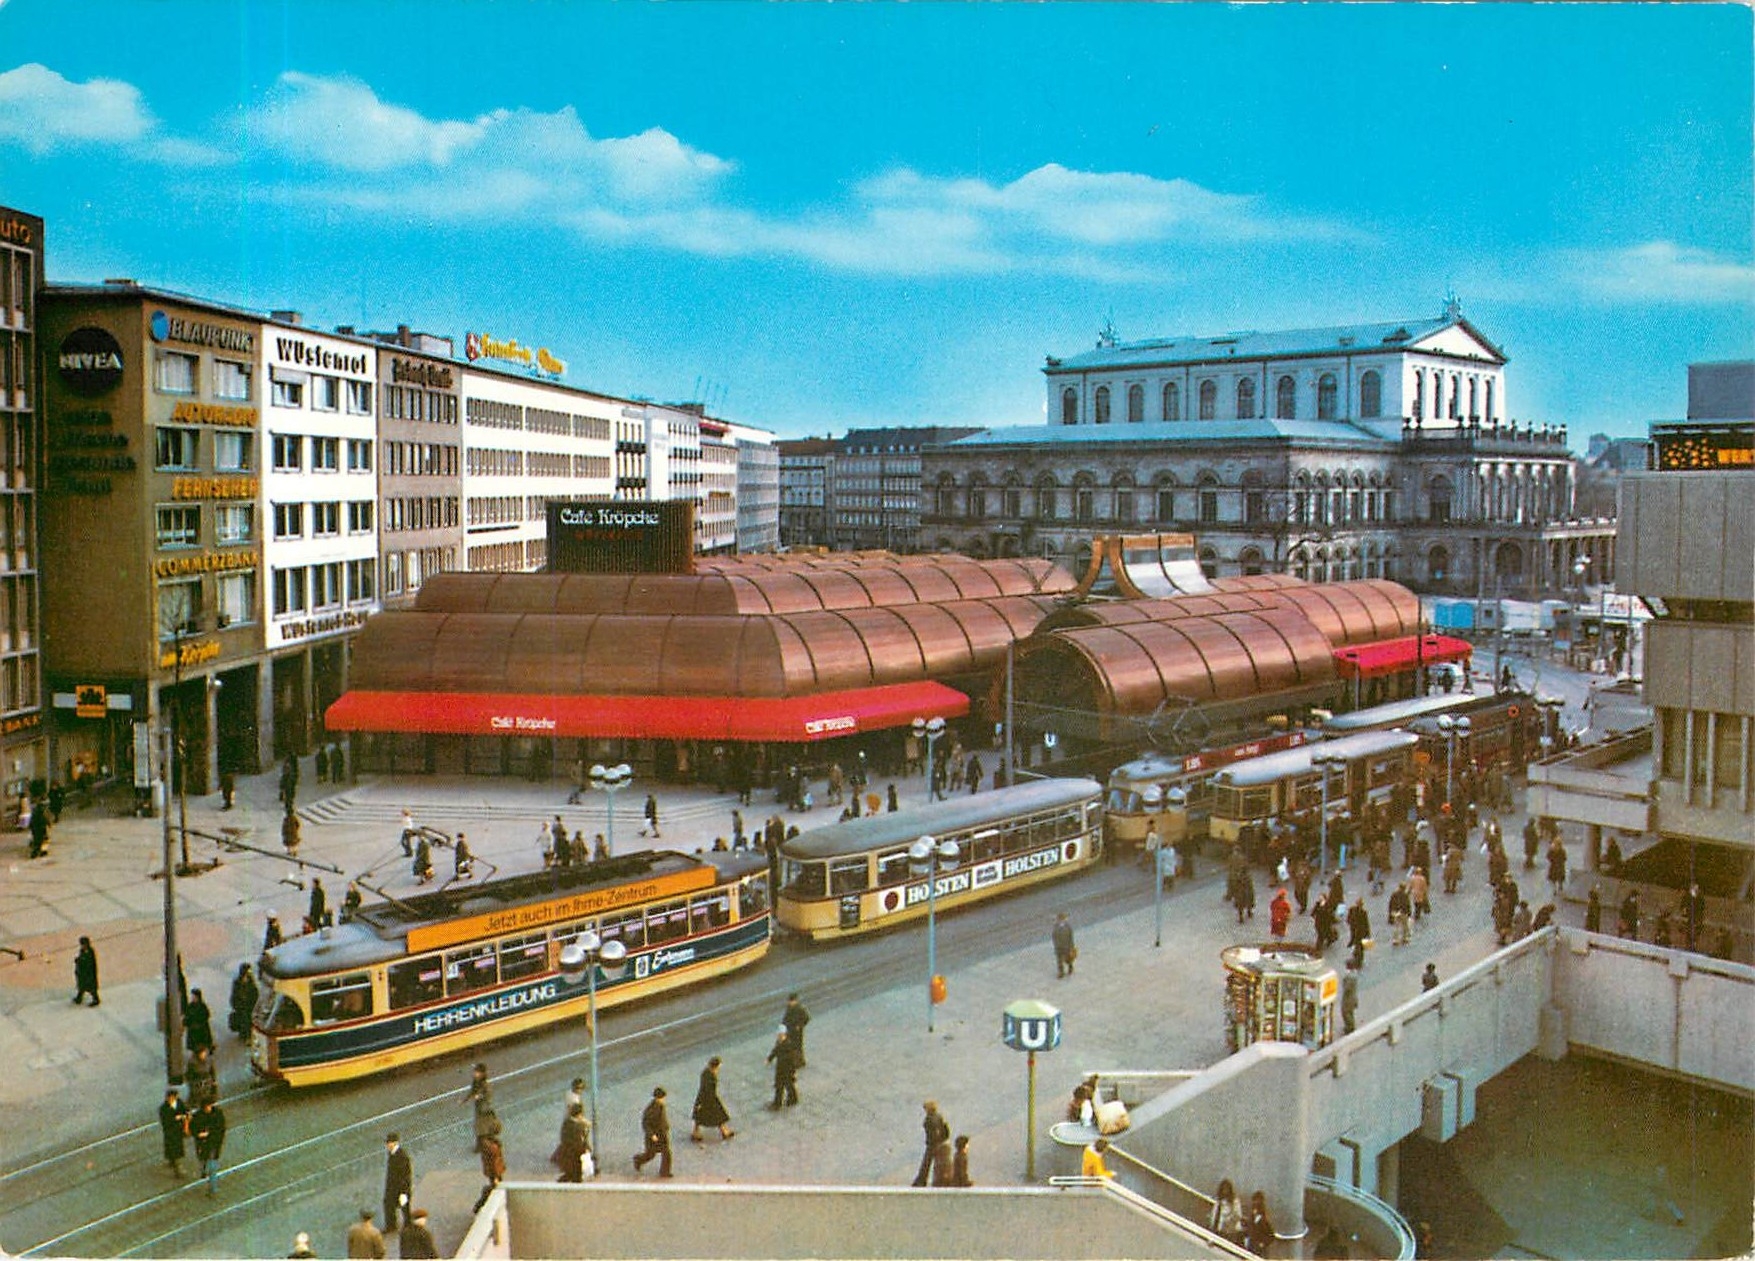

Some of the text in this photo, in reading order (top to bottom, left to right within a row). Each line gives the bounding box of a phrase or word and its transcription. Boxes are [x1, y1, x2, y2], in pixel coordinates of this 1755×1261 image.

[59, 352, 121, 369] NIVEA
[157, 549, 259, 577] COMMERZBANK
[1005, 847, 1059, 877] HOLSTEN
[907, 872, 970, 904] HOSTEN
[519, 905, 552, 923] auch
[555, 902, 571, 918] im
[414, 984, 556, 1034] HERRENKLEIDUNG
[1021, 1020, 1047, 1048] U
